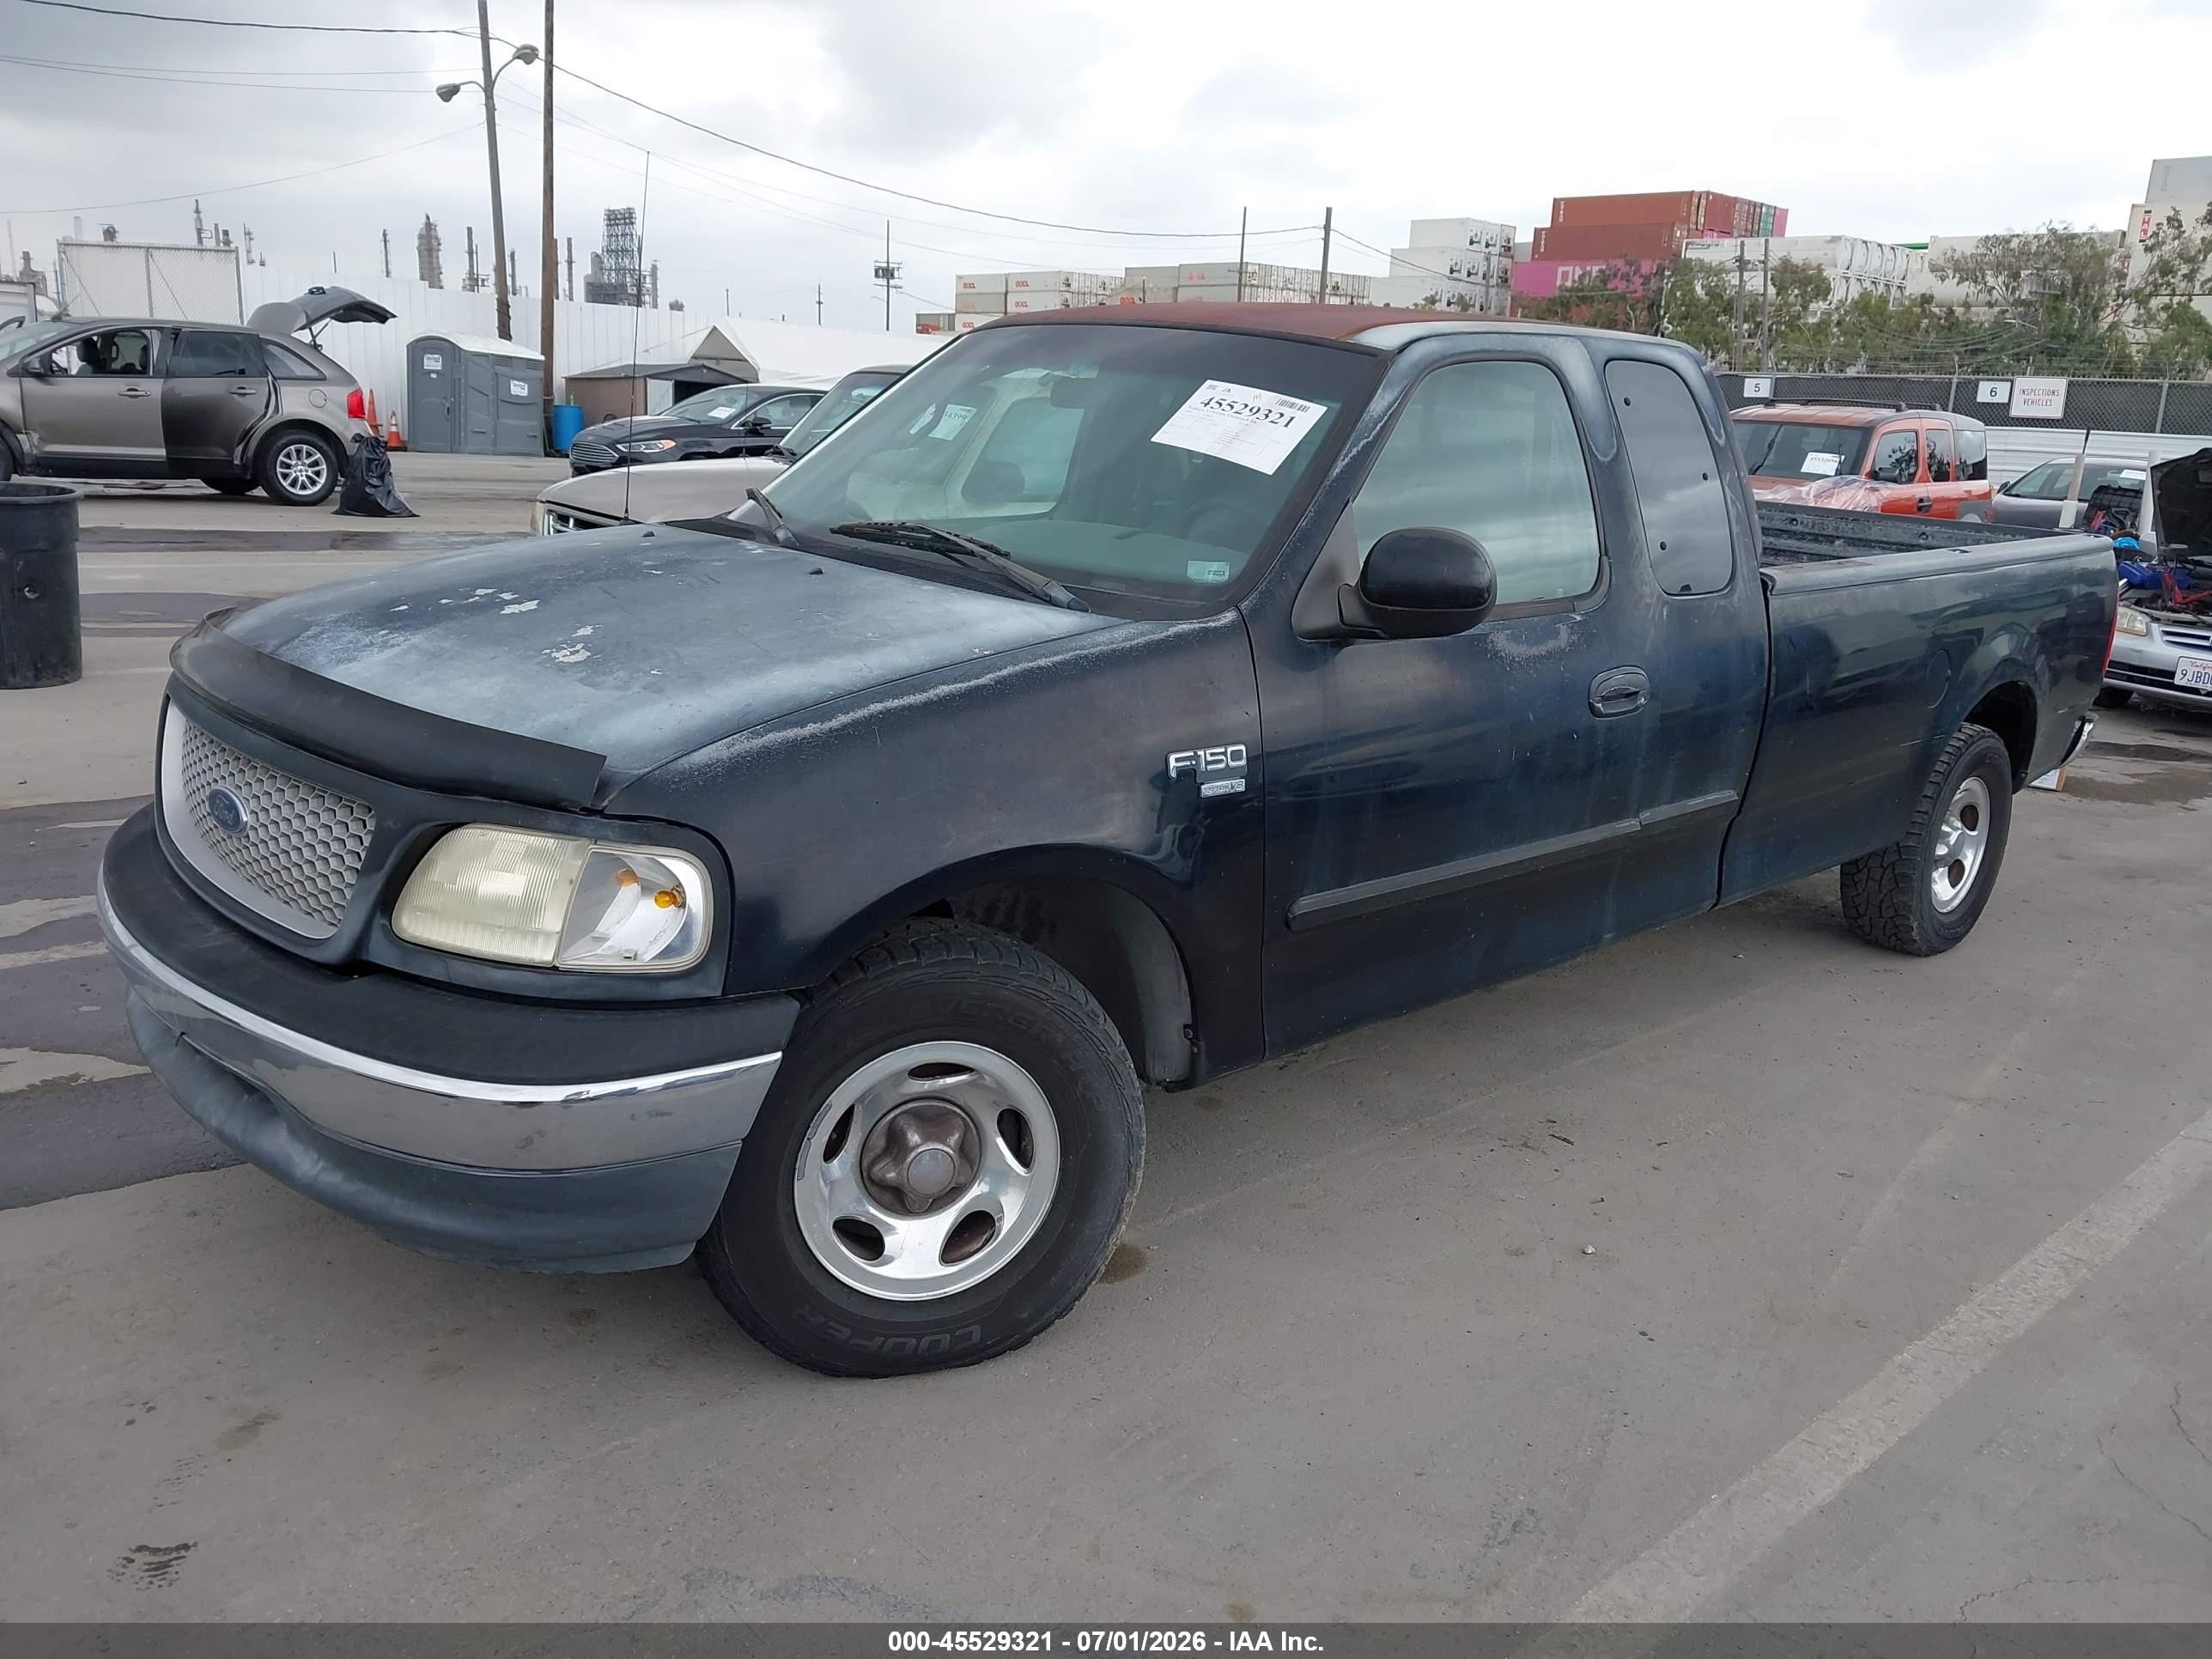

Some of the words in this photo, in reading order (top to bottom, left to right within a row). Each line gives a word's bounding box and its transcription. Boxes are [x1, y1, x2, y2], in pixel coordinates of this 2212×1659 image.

[1753, 382, 1761, 393] 5
[1989, 386, 1999, 398] 6
[2019, 387, 2061, 397] INSPECTIONS
[2023, 398, 2053, 407] VEHICLES
[1200, 396, 1296, 428] 45529321
[2179, 669, 2212, 686] 9JBD
[212, 793, 237, 825] Ford
